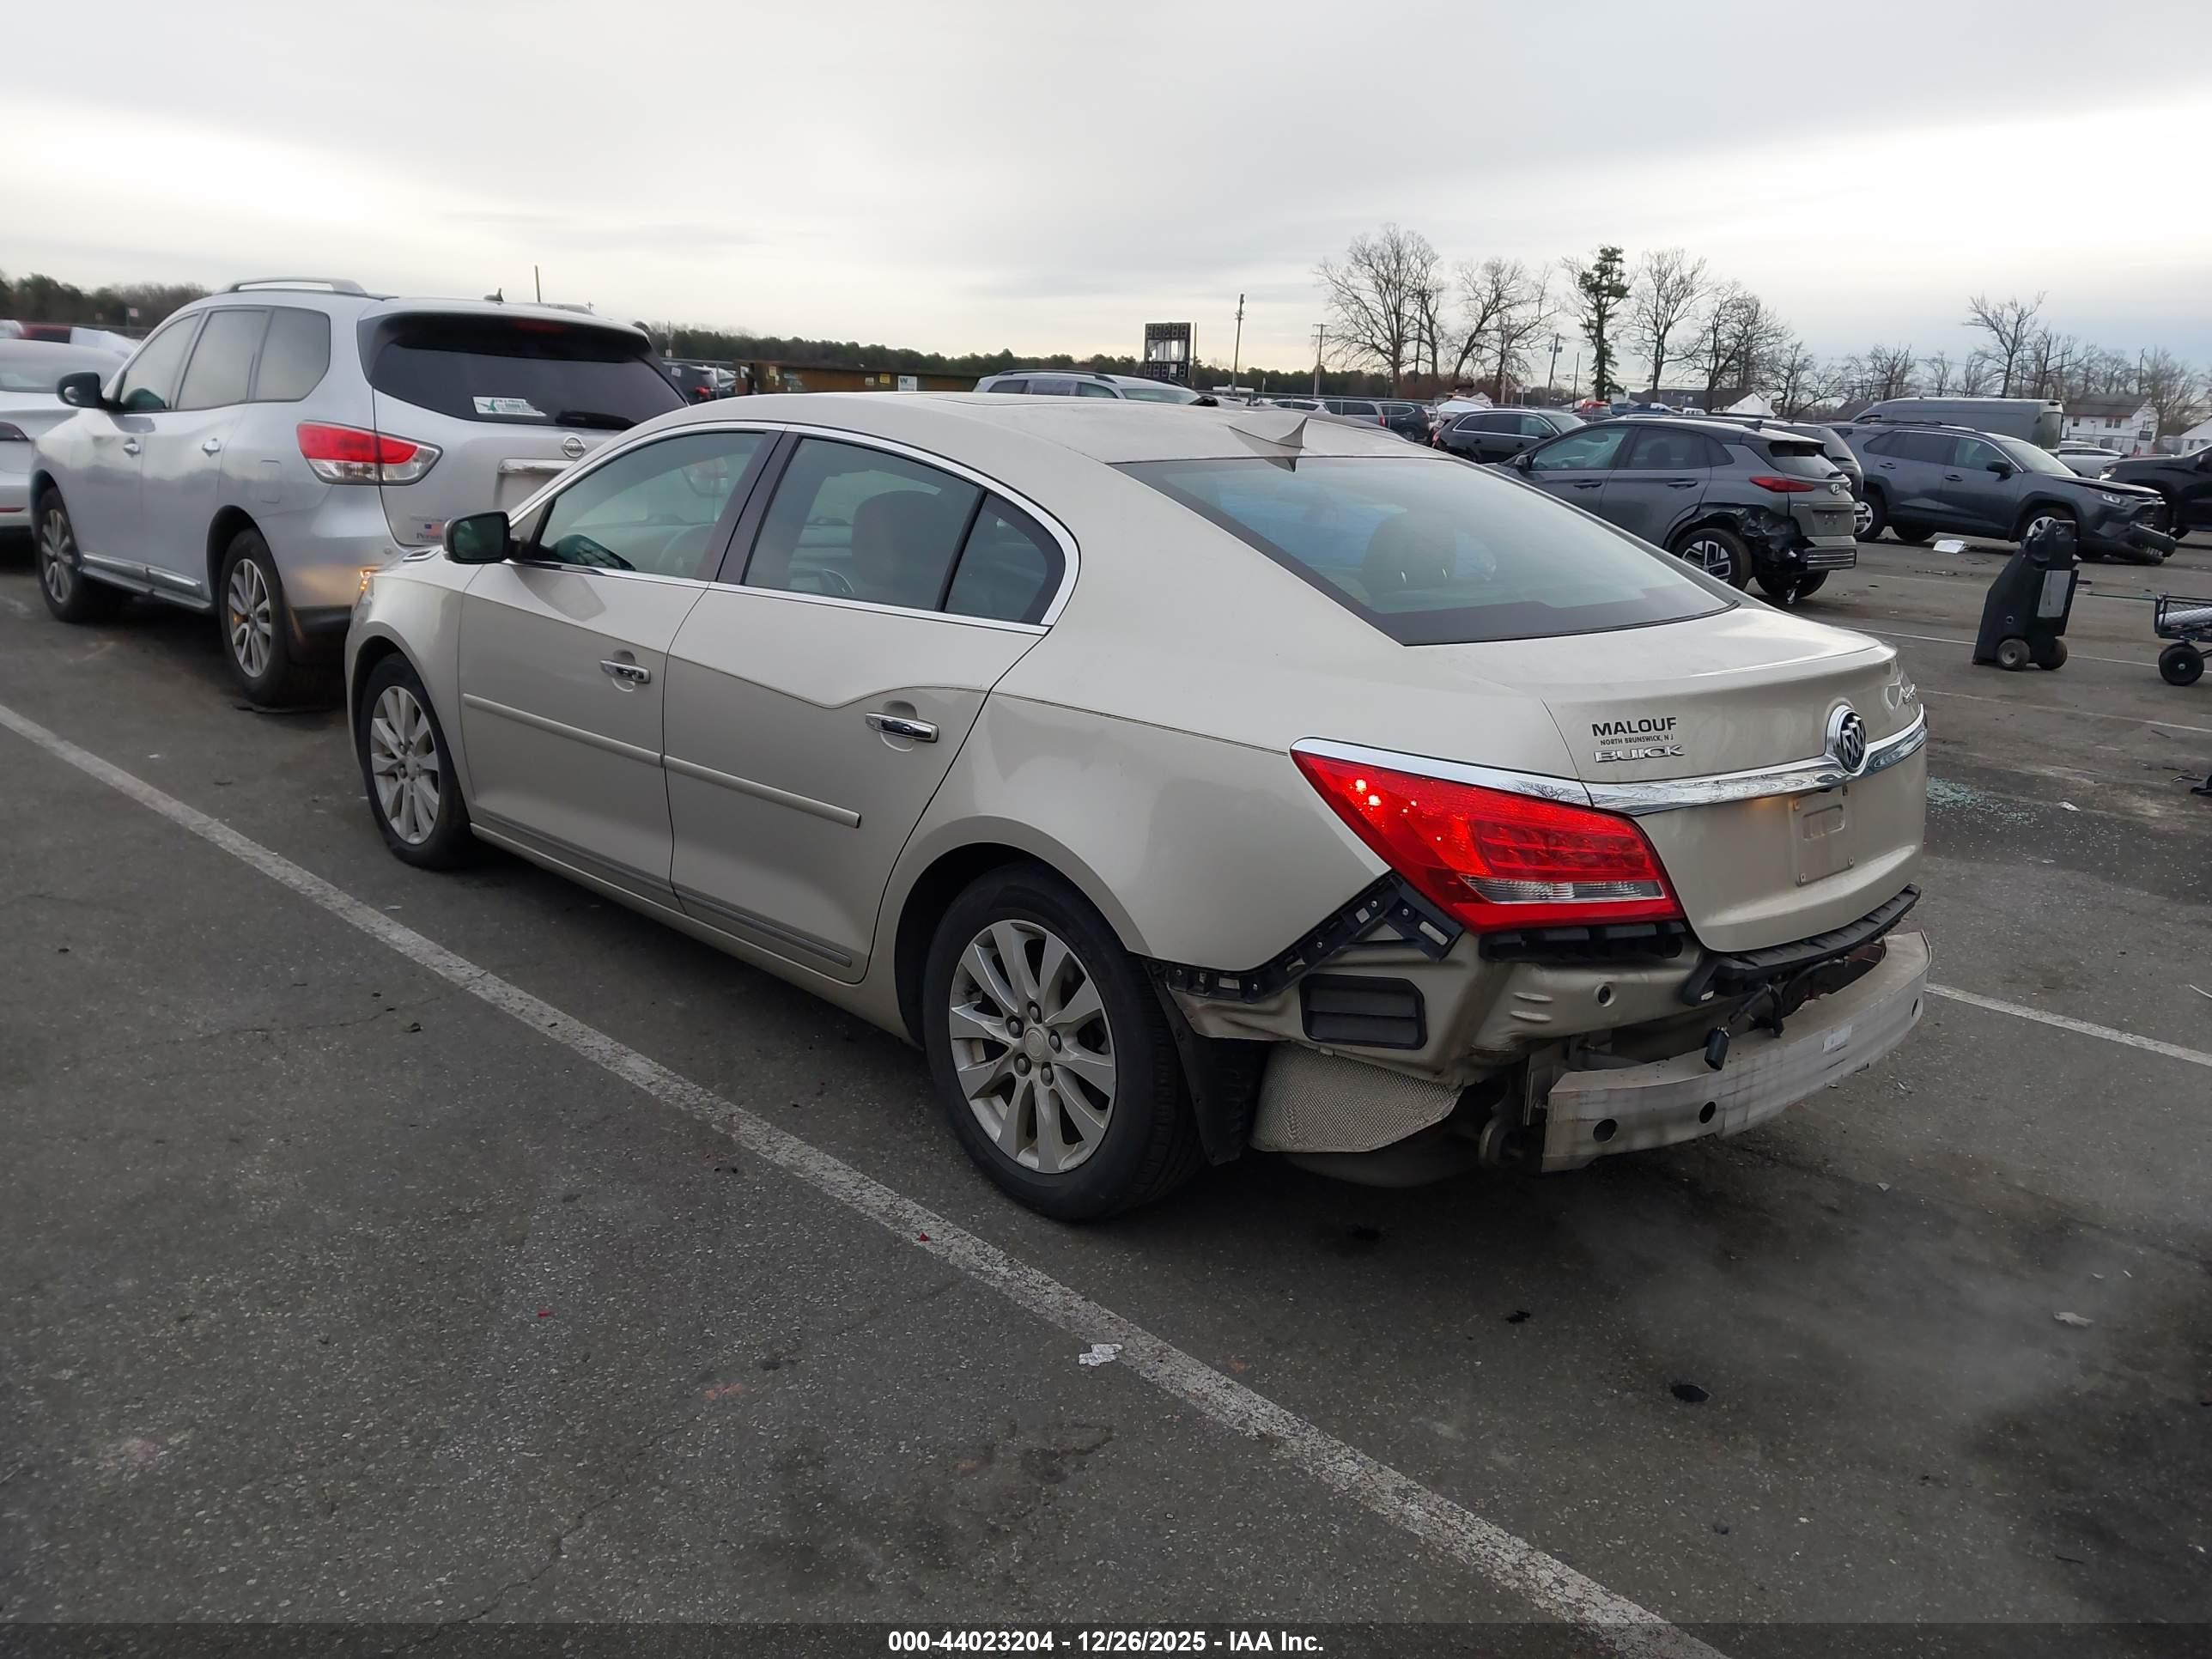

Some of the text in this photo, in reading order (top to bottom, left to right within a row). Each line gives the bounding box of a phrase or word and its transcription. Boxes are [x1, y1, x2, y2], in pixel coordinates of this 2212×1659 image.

[1591, 716, 1677, 737] MALOUF
[1600, 738, 1623, 746] NORTH
[1594, 744, 1685, 763] BUICK
